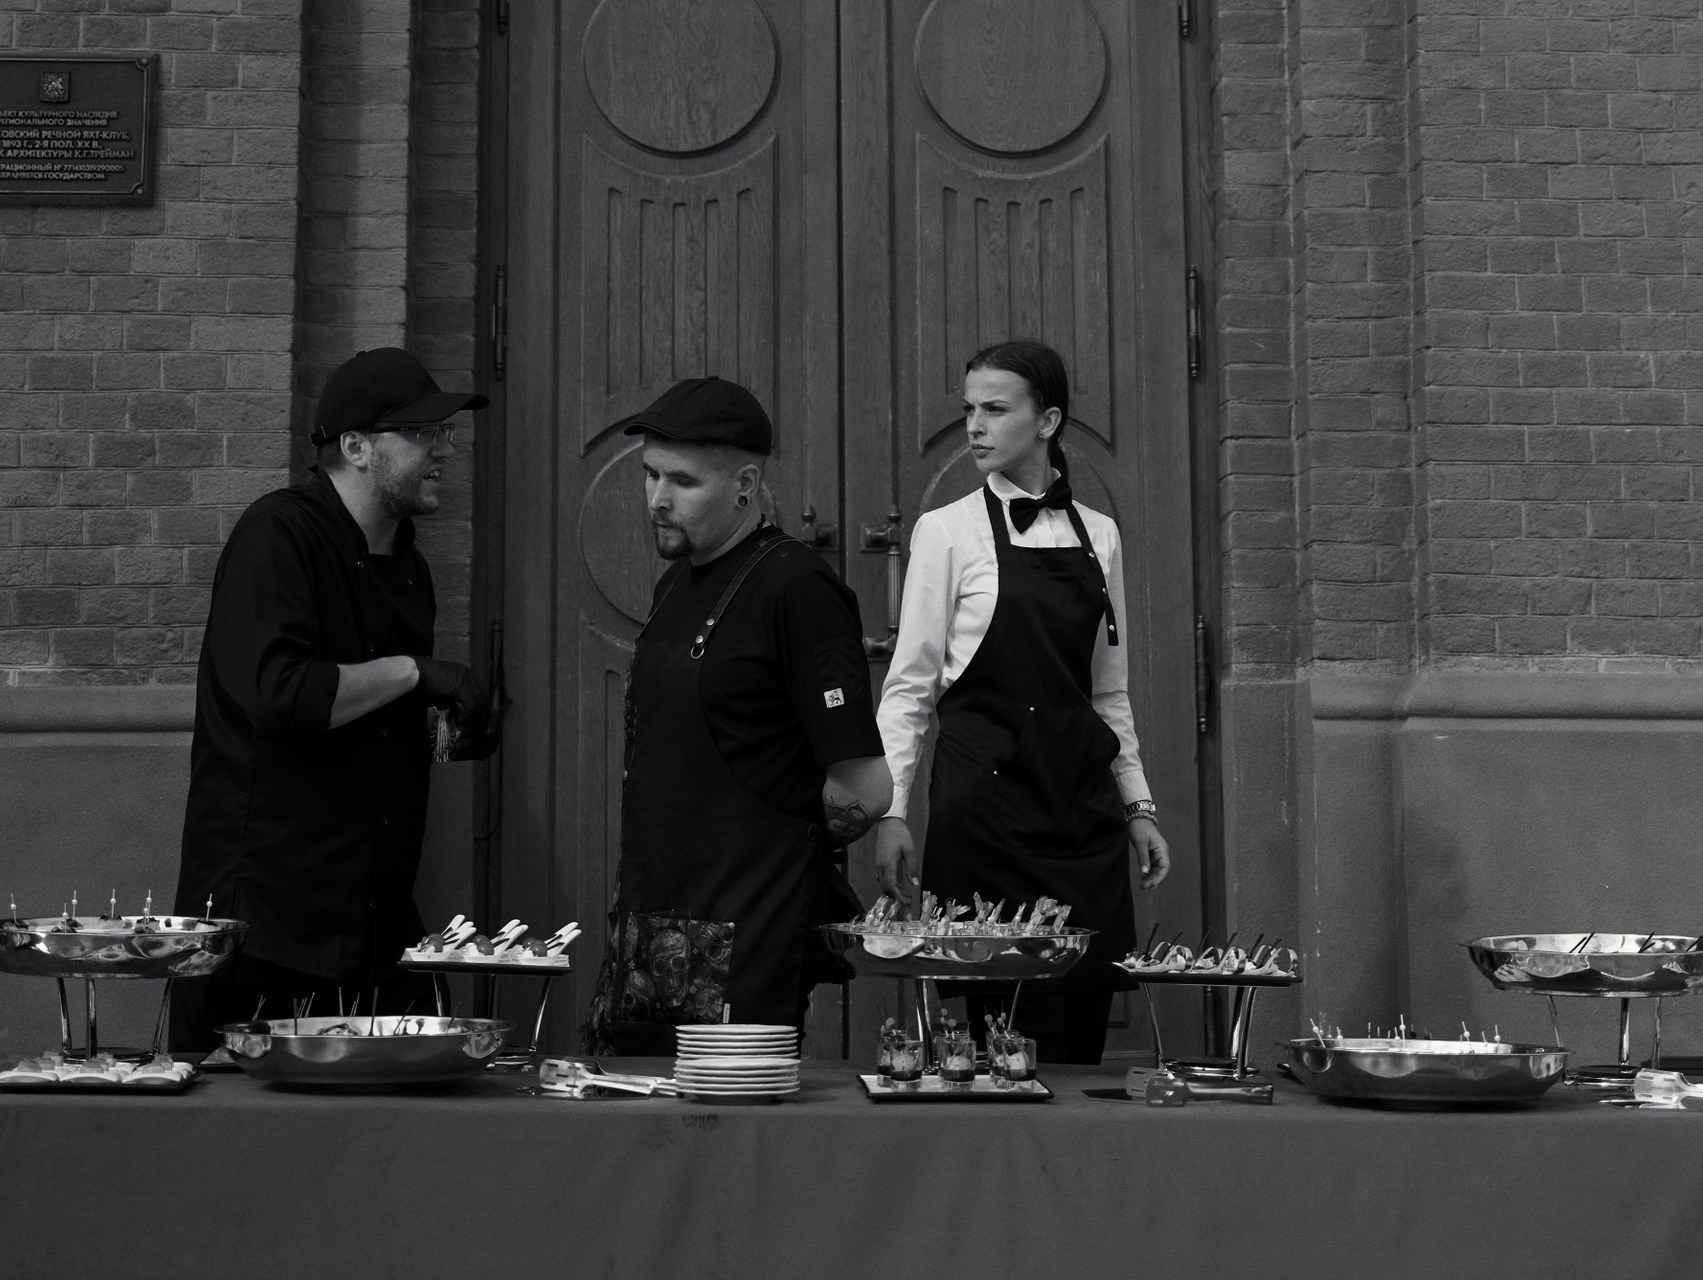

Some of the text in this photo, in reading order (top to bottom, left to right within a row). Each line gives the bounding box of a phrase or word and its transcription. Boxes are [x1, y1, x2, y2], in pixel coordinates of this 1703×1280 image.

[0, 129, 40, 139] ОВСКИЙ
[41, 129, 81, 139] РЕЧНОЙ
[2, 140, 22, 148] 1893
[6, 149, 73, 158] АРХИТЕКТУРЫ
